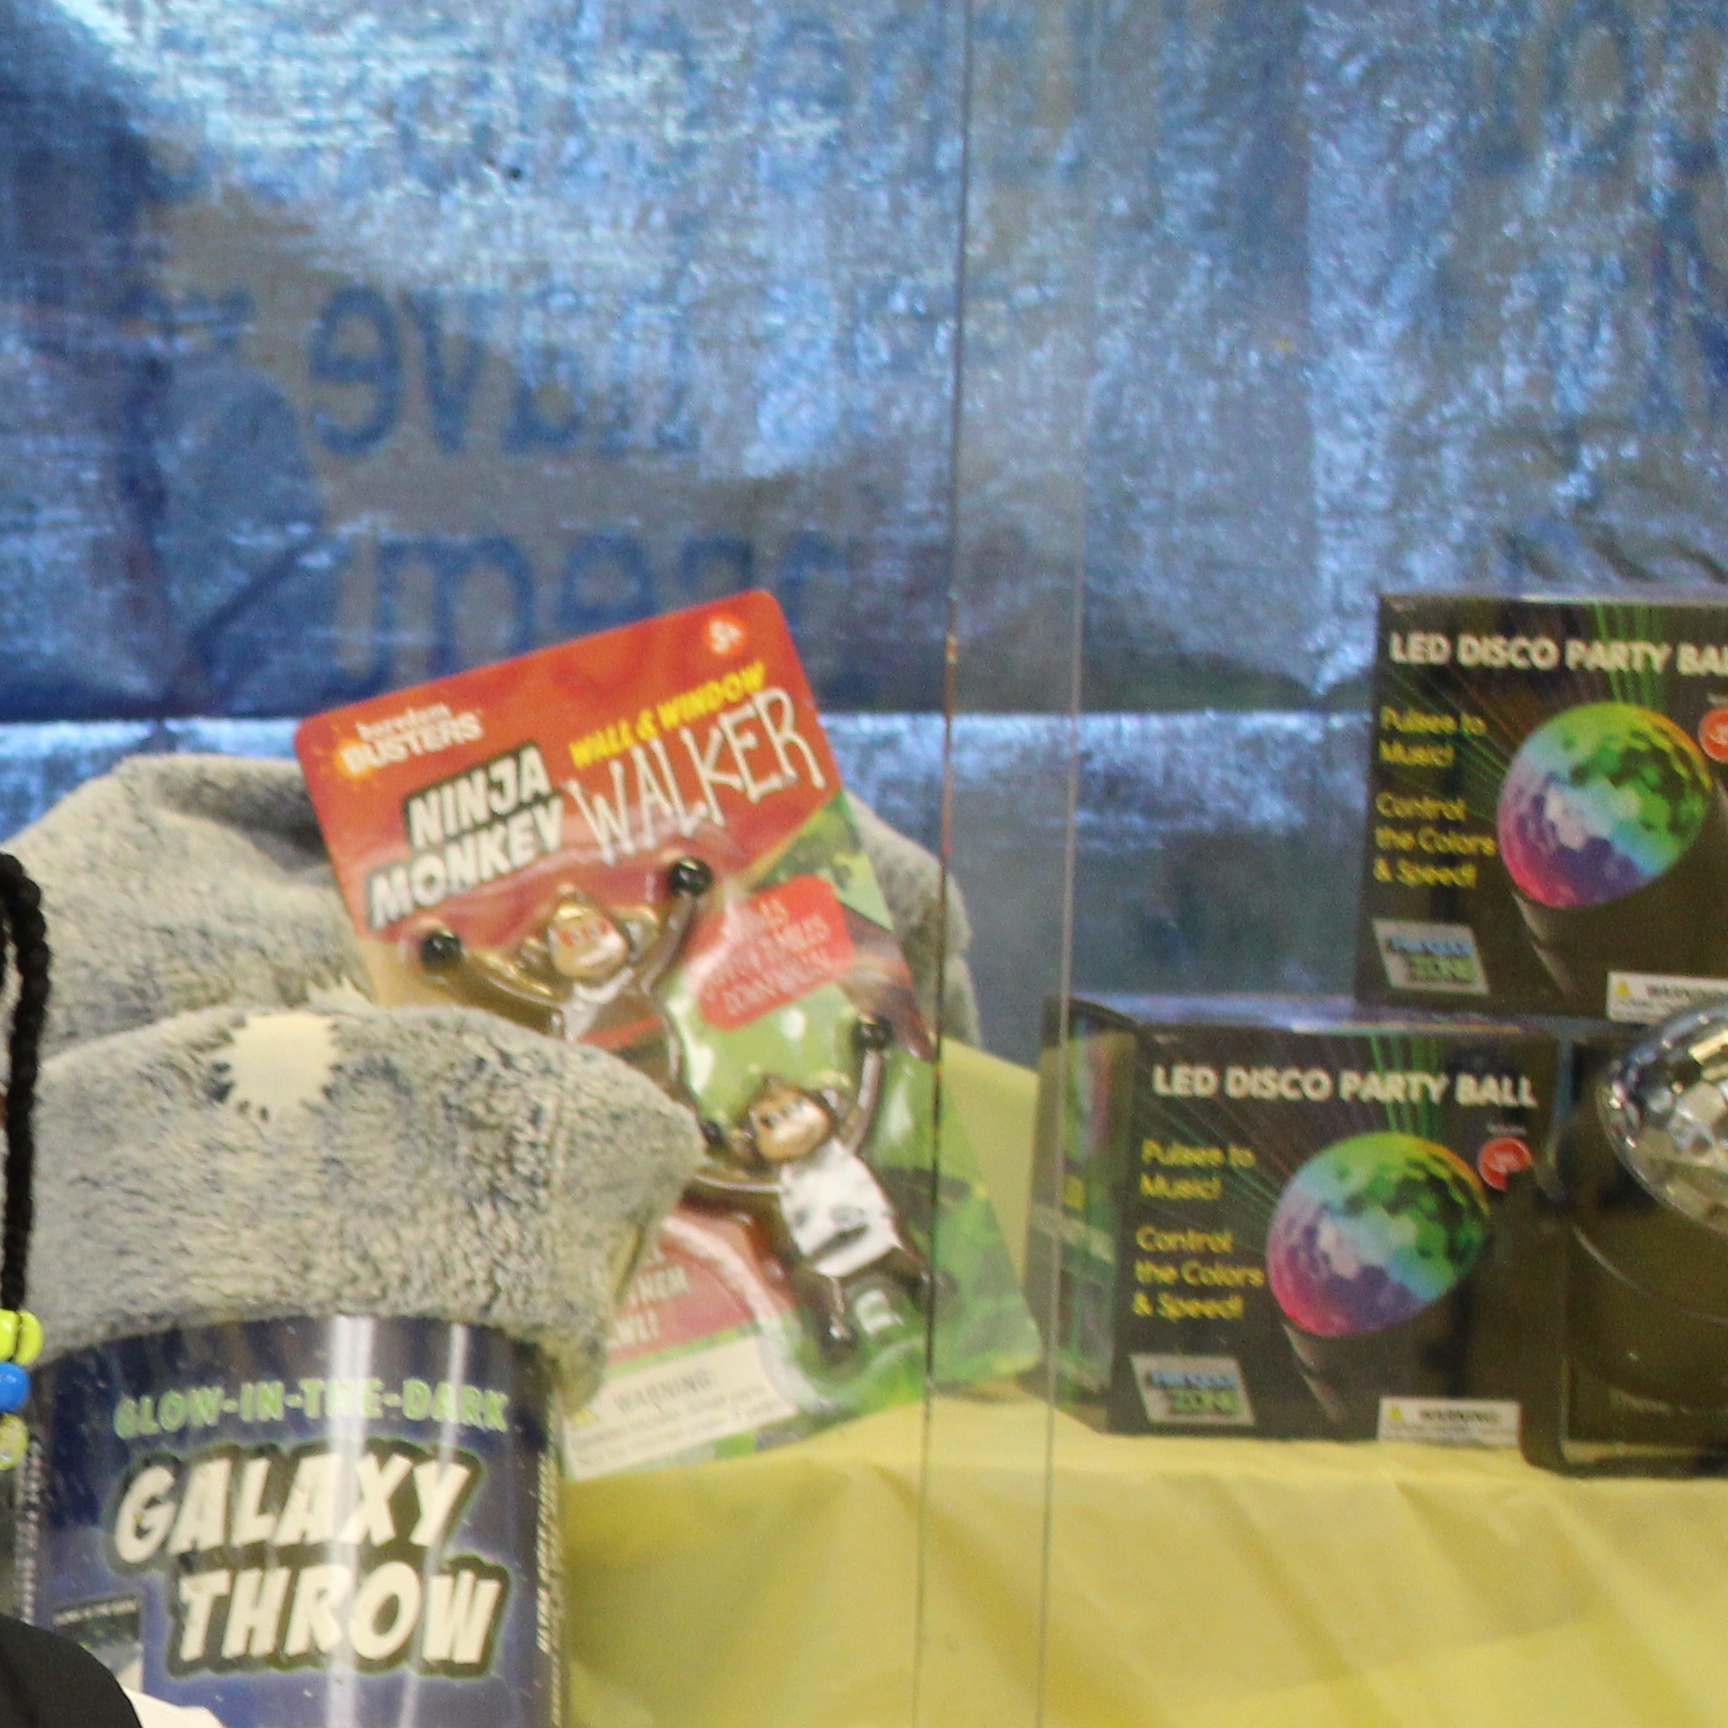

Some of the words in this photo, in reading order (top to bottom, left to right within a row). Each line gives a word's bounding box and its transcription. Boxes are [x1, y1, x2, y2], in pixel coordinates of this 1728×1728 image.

[1389, 631, 1451, 665] LED
[1457, 633, 1560, 671] DISCO
[1565, 638, 1674, 675] PARTY
[568, 718, 636, 770] WALL
[656, 659, 767, 731] WINDOW
[1459, 711, 1488, 736] to
[339, 711, 484, 774] BUSTERS
[407, 744, 554, 850] NINJA
[563, 686, 827, 867] WALKER
[1375, 791, 1467, 822] Control
[368, 795, 564, 931] MONKEY
[1375, 826, 1416, 850] the
[1417, 826, 1497, 857] Colors
[1373, 857, 1394, 883] &
[1152, 1064, 1218, 1098] LED
[1223, 1066, 1334, 1102] DISCO
[1338, 1070, 1450, 1105] PARTY
[1454, 1073, 1538, 1108] BALL
[1227, 1143, 1258, 1169] to
[1135, 1225, 1234, 1254] Control
[1133, 1258, 1179, 1285] the
[1181, 1258, 1266, 1288] Colors
[1132, 1290, 1154, 1316] &
[115, 1451, 471, 1565] GALAXY
[178, 1560, 502, 1664] THROW
